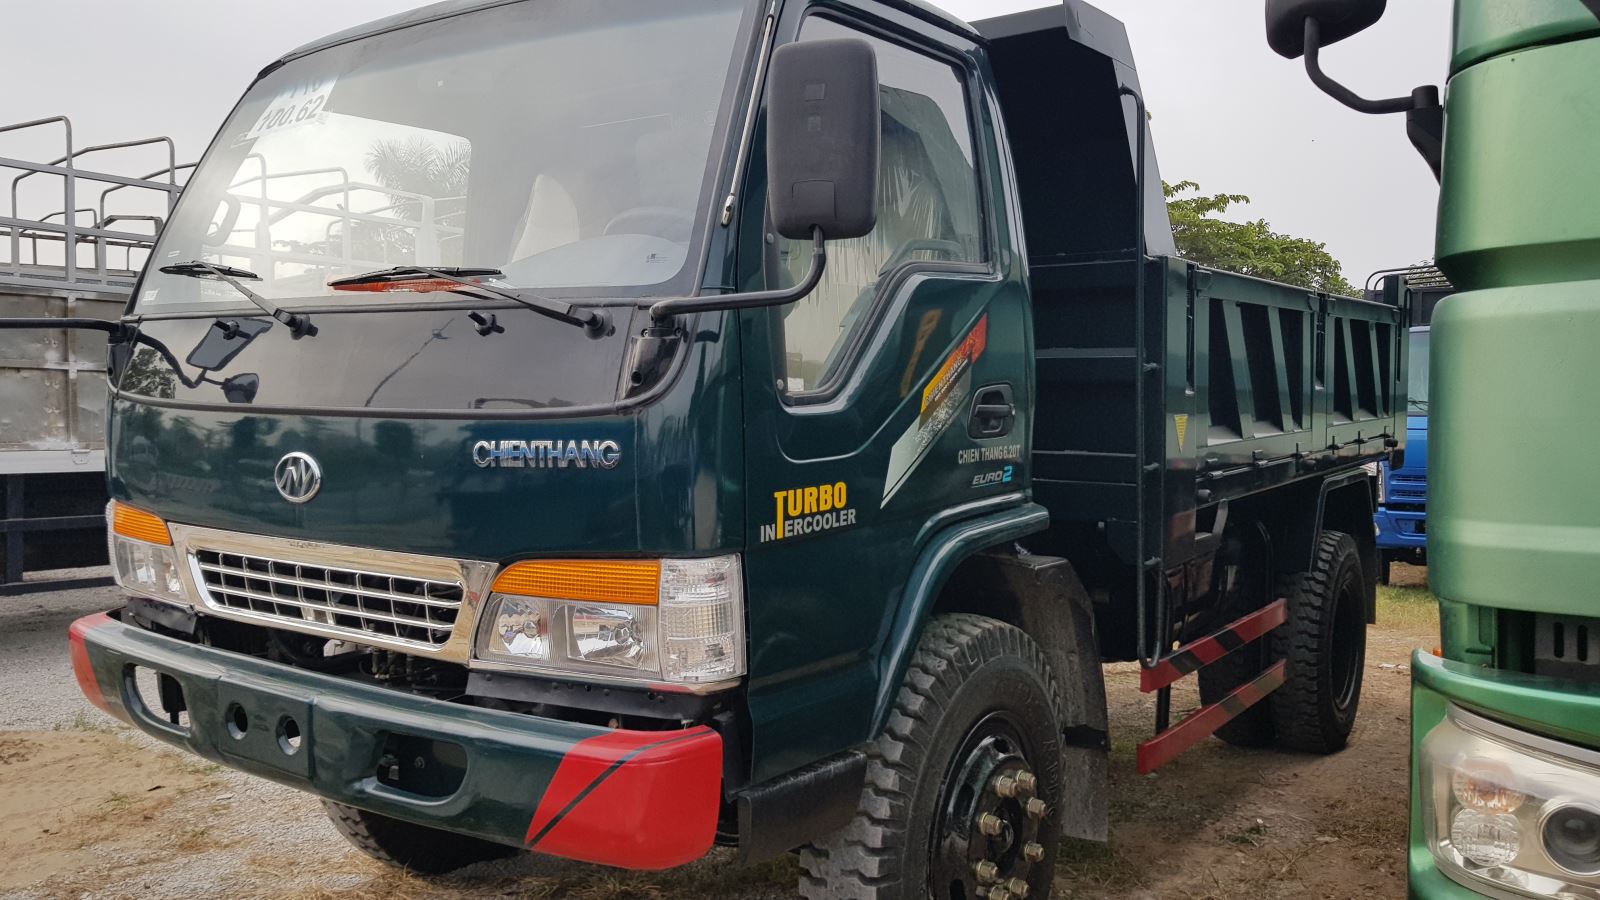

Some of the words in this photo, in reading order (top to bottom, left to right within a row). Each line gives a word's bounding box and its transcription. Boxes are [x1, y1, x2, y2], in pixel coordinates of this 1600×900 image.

[472, 439, 622, 470] CHIENTHANG
[958, 447, 980, 465] CHIEN
[760, 508, 857, 543] INTERCOOLER
[773, 481, 847, 540] TURBO
